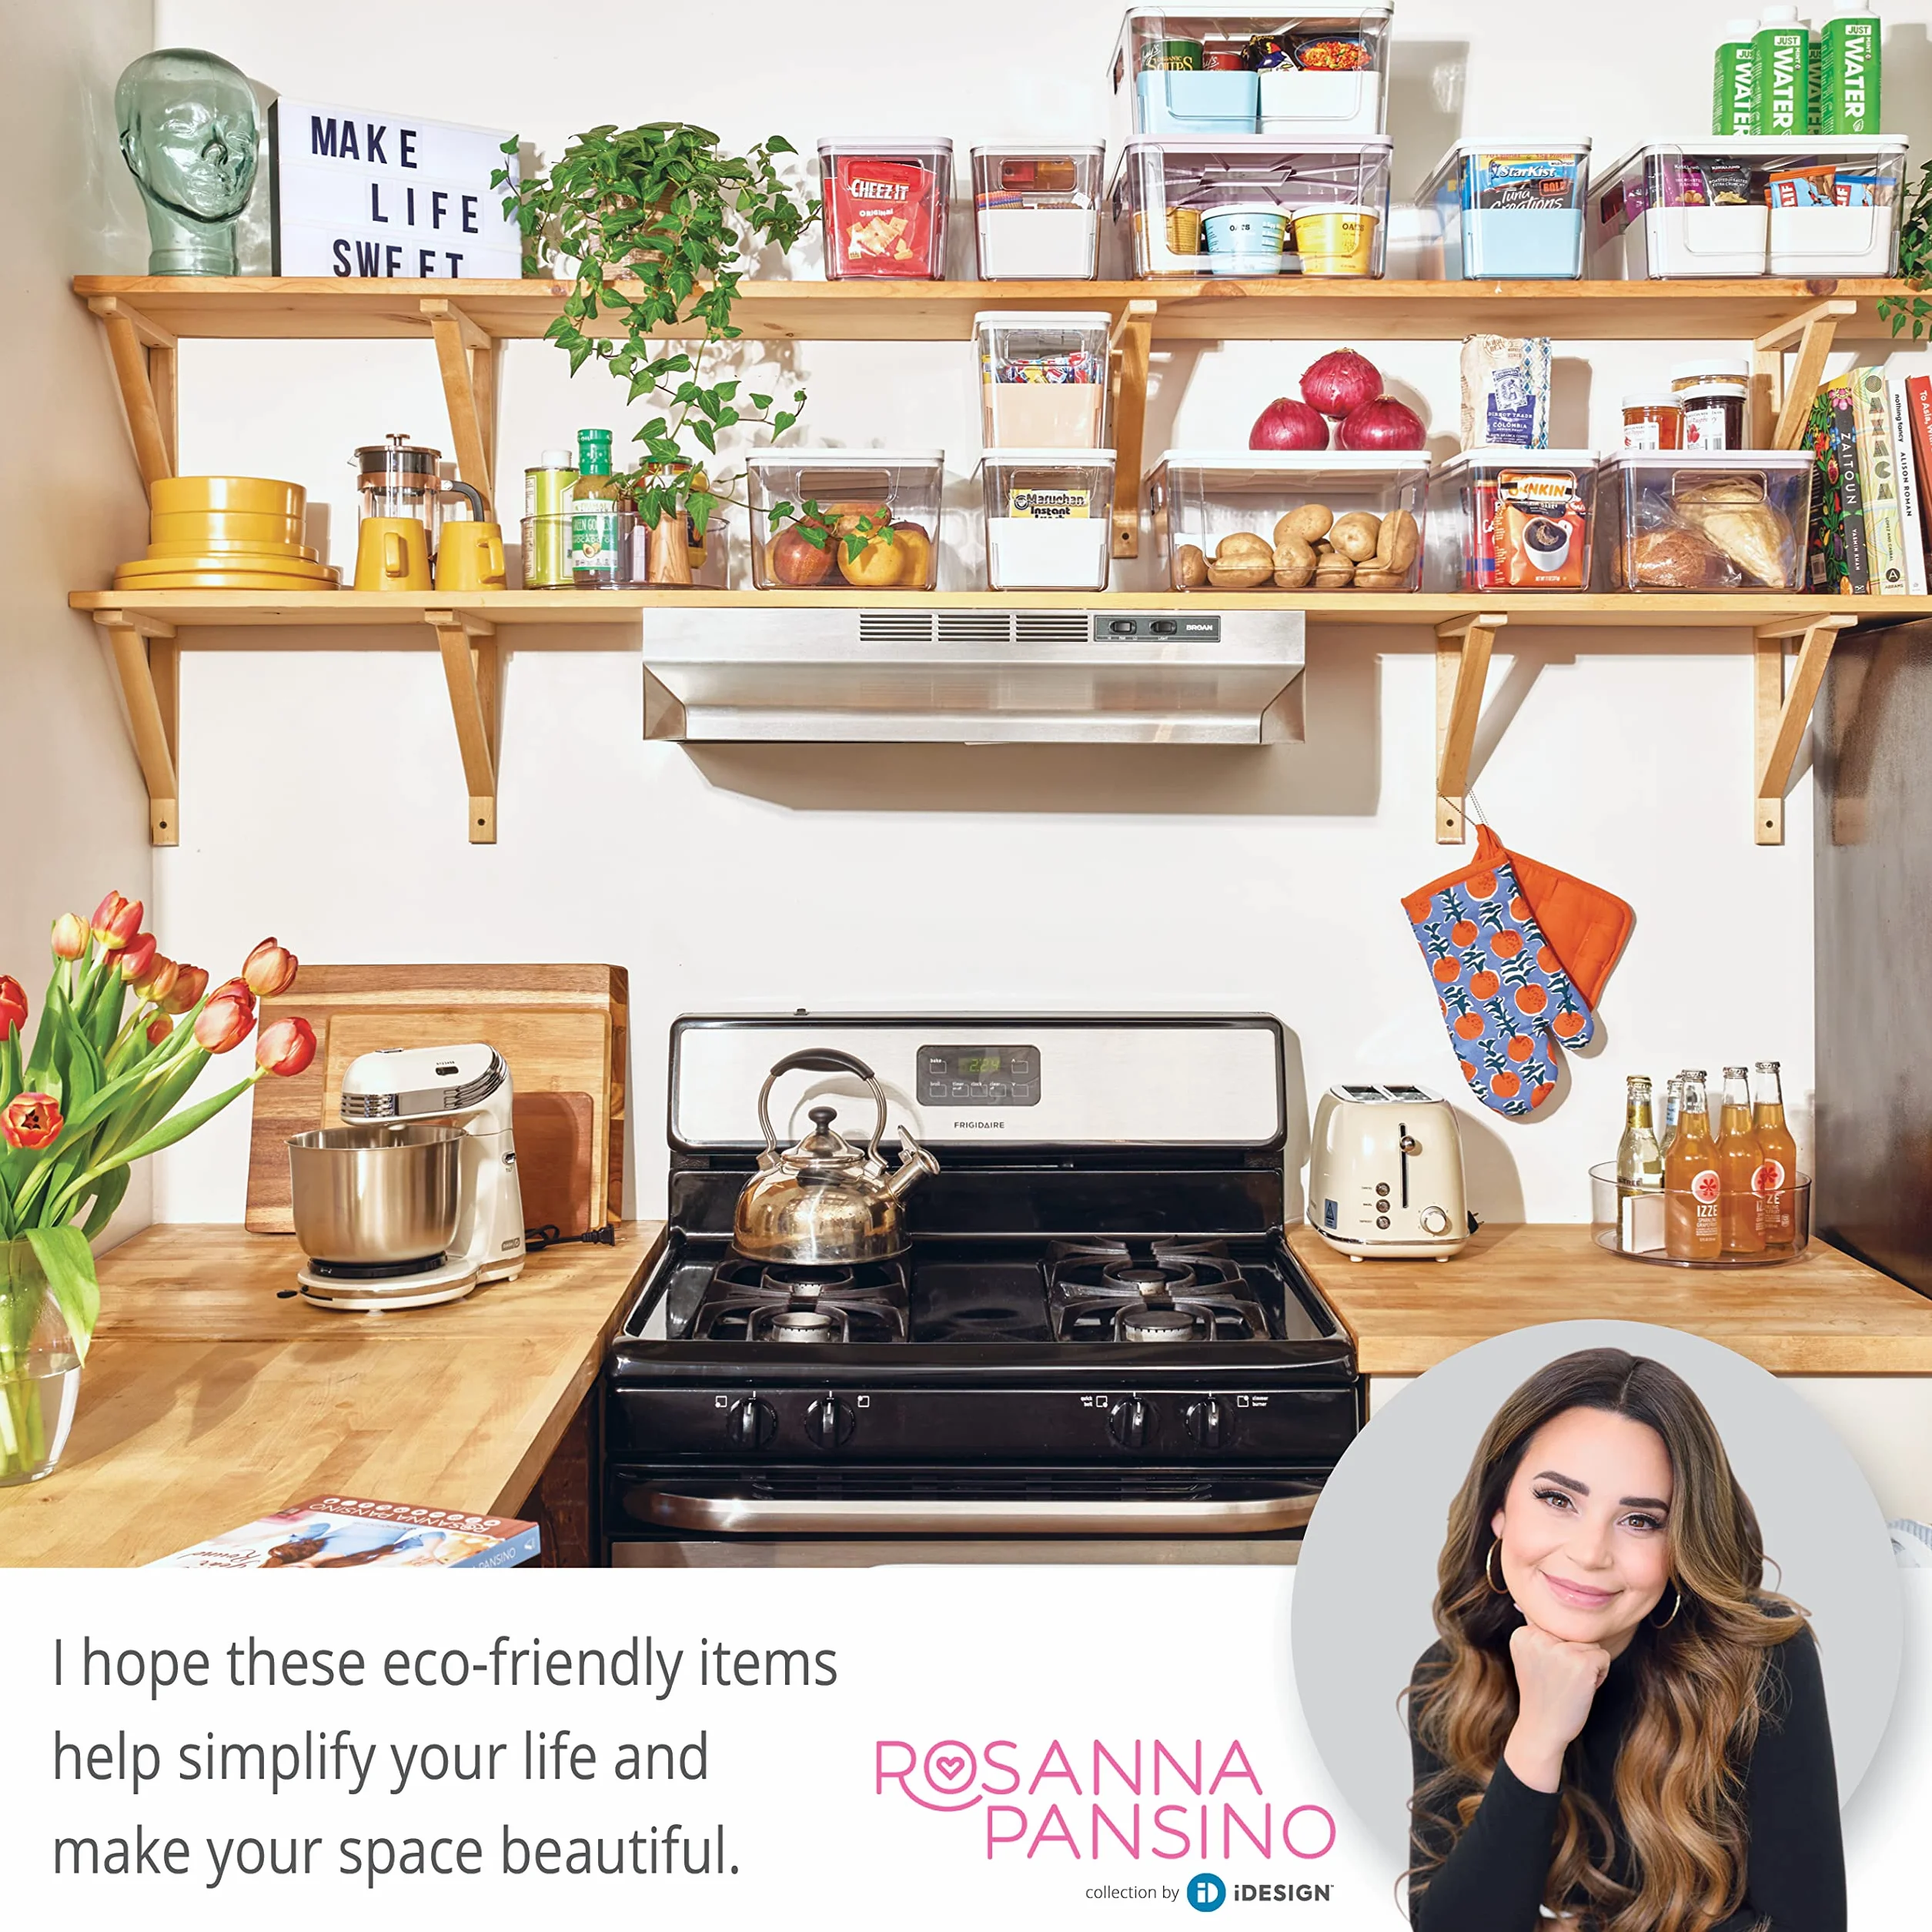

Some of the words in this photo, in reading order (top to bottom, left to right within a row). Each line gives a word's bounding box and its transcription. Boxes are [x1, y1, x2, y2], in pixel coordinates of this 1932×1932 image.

[1809, 50, 1822, 58] JUS
[1845, 37, 1865, 118] WATER
[1773, 48, 1794, 129] WATER
[311, 115, 418, 169] MAKE
[1500, 165, 1556, 179] StarKist
[1502, 186, 1530, 204] Tuna
[1543, 181, 1566, 192] BOLD
[1781, 186, 1796, 207] LIF
[372, 183, 479, 233] LIFE
[1920, 389, 1928, 401] To
[1840, 433, 1857, 504] ZAITOUN
[1900, 451, 1909, 483] ALISON
[1027, 493, 1085, 506] Maruchan
[1030, 506, 1071, 515] Instant
[1766, 1194, 1780, 1205] ZE
[1696, 1205, 1718, 1217] IZZE
[309, 1503, 394, 1519] PANSINO
[397, 1514, 490, 1533] ROSANNA
